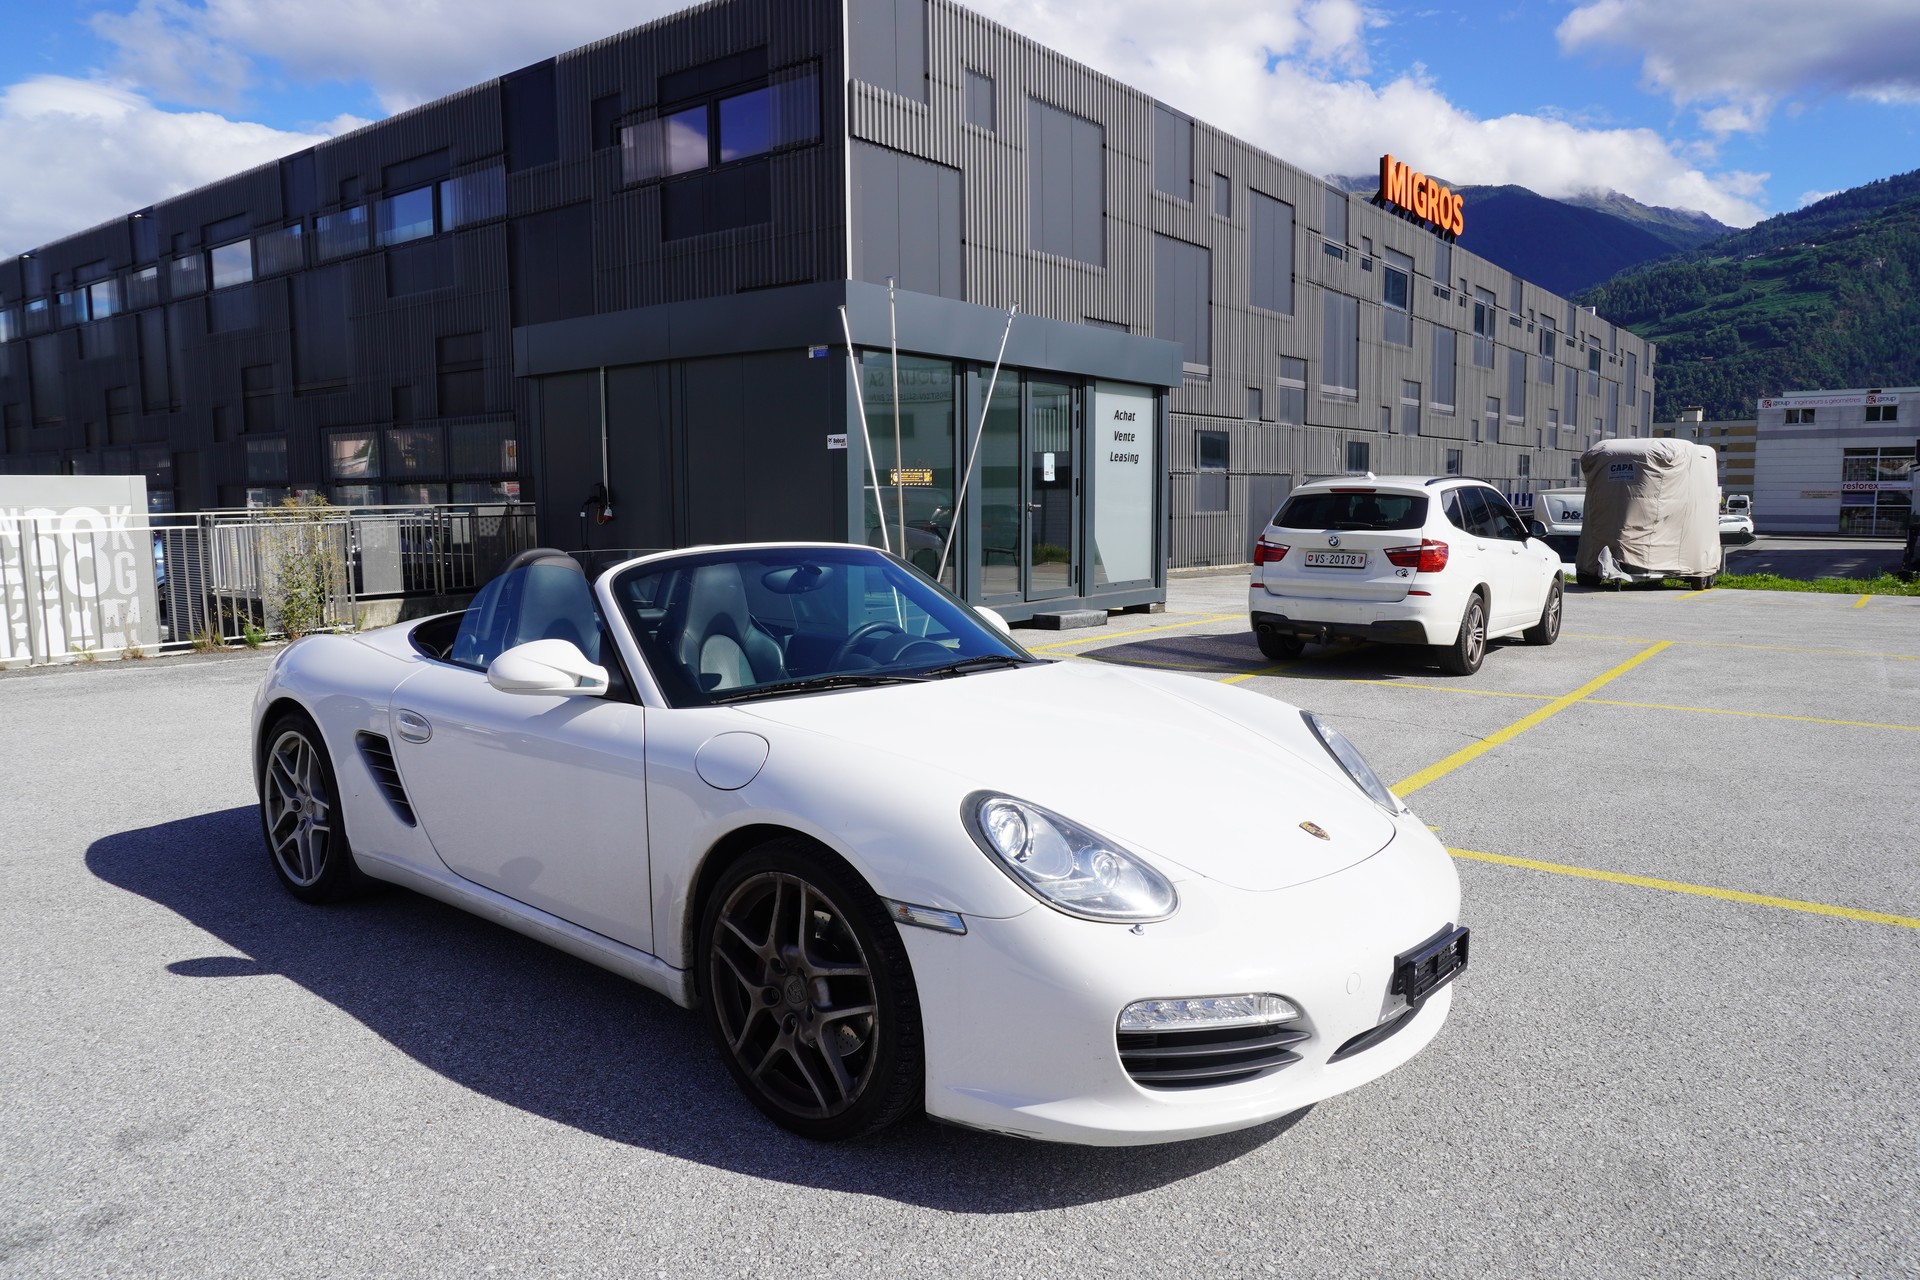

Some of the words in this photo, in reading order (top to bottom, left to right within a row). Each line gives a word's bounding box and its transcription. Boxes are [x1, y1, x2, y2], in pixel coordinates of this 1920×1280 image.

[1384, 154, 1463, 236] MIGROS
[1877, 395, 1897, 403] group
[1114, 410, 1136, 421] Achat
[1114, 431, 1136, 442] Vente
[1110, 451, 1139, 464] Leasing
[1611, 463, 1634, 472] CAPA
[1842, 481, 1879, 490] restorex
